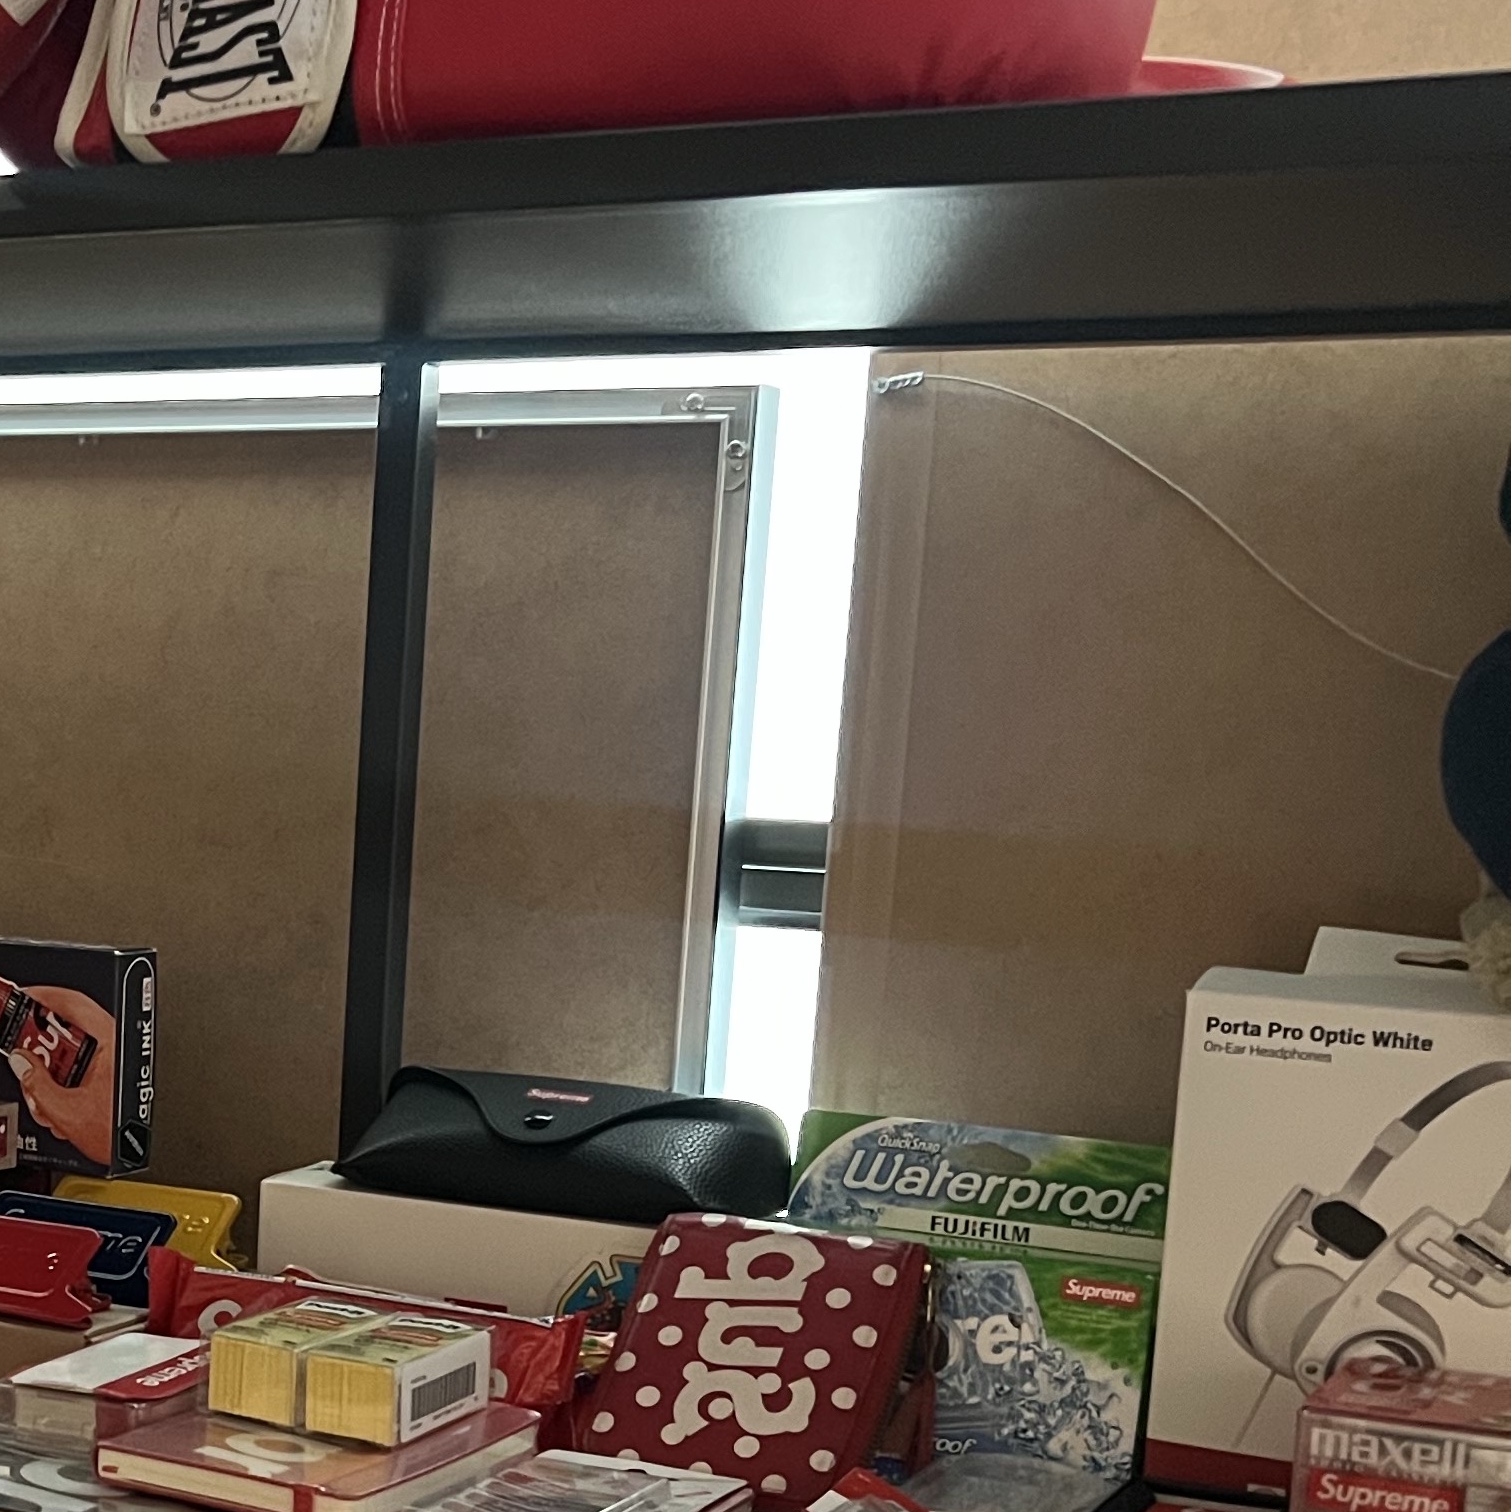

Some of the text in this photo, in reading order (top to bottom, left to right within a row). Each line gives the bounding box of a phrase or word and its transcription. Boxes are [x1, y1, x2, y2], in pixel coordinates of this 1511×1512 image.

[1205, 1016, 1434, 1052] Porta Pro Optic White
[1203, 1041, 1333, 1064] On-Ear Headphones
[877, 1133, 941, 1154] QuickSnap
[842, 1149, 1166, 1223] Waterproof
[929, 1215, 1031, 1244] FUJIFILM
[1065, 1278, 1137, 1304] Supreme
[1309, 1426, 1467, 1478] maxell
